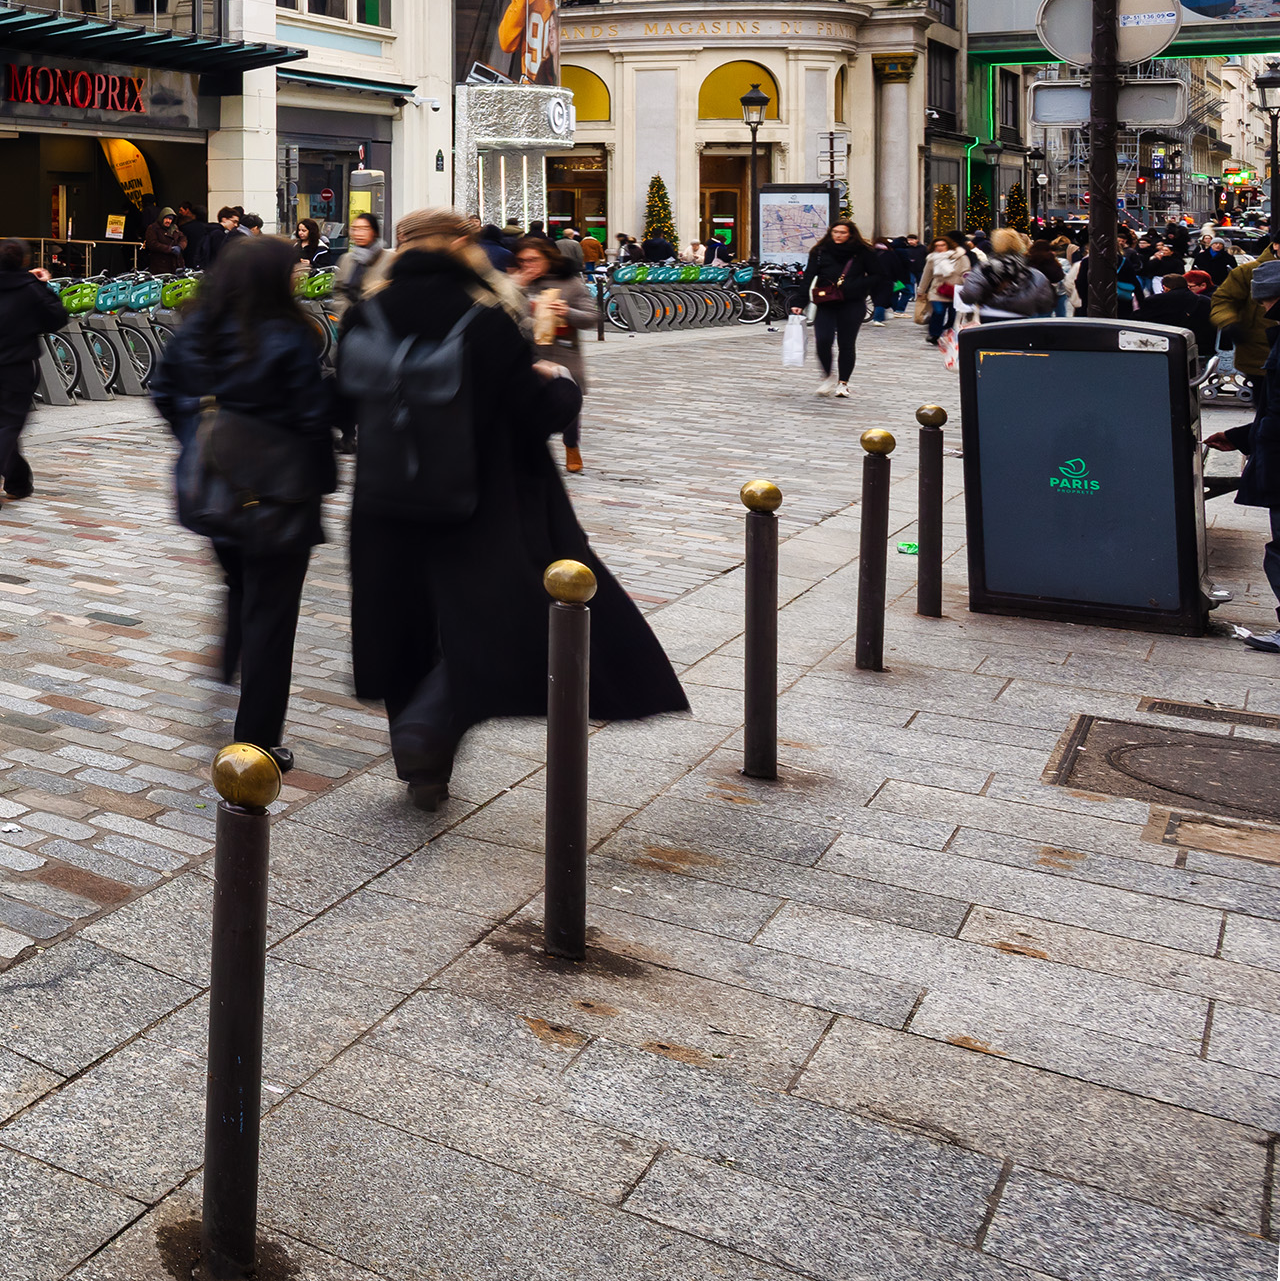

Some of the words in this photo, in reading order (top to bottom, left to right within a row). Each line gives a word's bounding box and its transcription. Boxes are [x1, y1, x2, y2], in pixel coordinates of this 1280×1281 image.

[560, 24, 619, 40] ANDS
[643, 21, 762, 36] MAGASINS
[780, 21, 803, 35] DU
[7, 63, 148, 113] MONOPRIX
[121, 178, 143, 191] MATIN
[1050, 477, 1100, 490] PARIS
